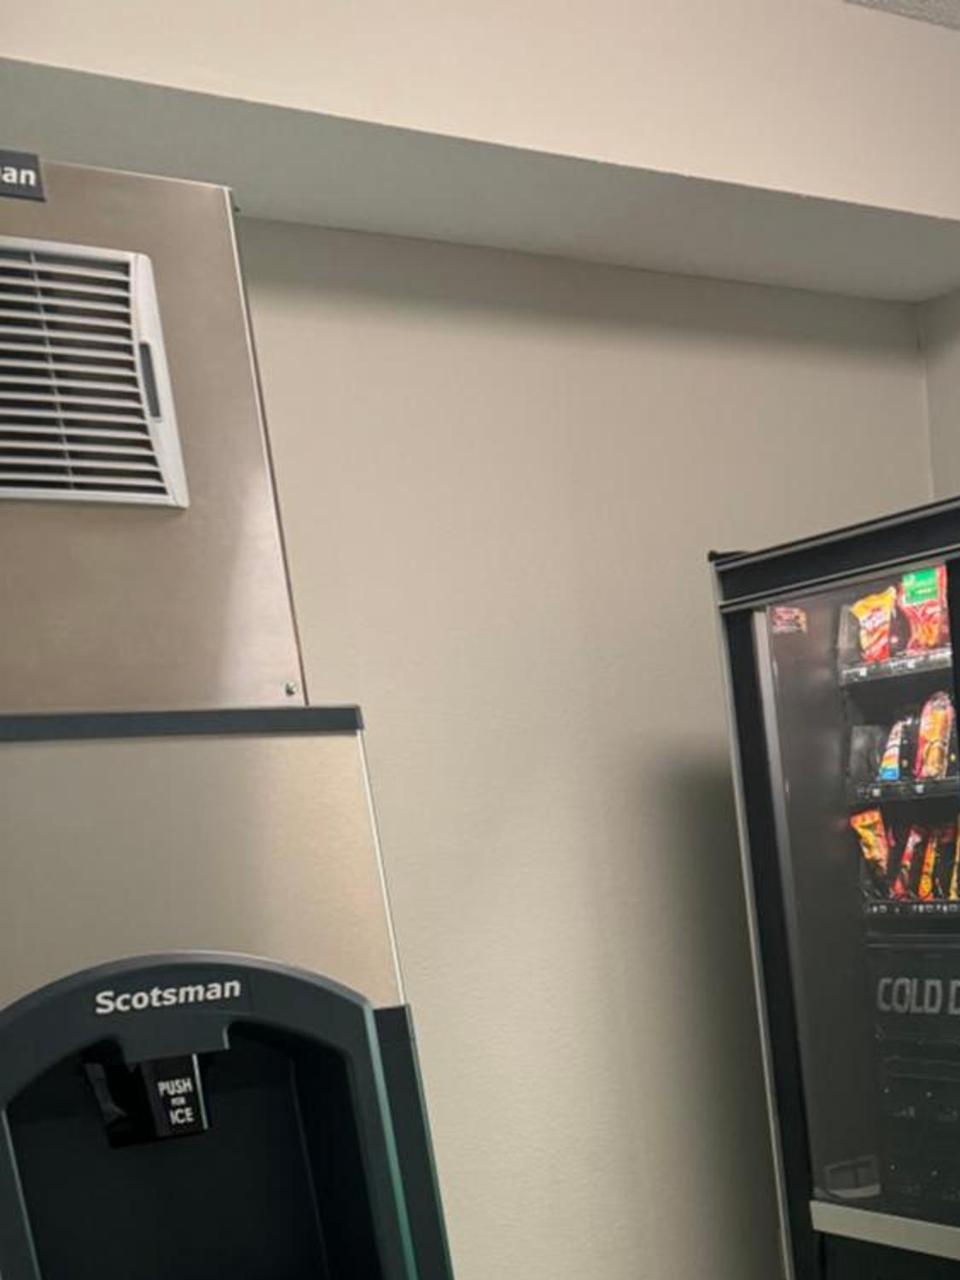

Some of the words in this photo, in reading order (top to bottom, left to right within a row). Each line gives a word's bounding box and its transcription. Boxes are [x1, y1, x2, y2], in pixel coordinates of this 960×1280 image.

[0, 166, 36, 186] an
[95, 979, 242, 1015] Scotsman
[877, 977, 943, 1014] COLD
[157, 1077, 193, 1098] PUSH
[169, 1107, 195, 1125] ICE
